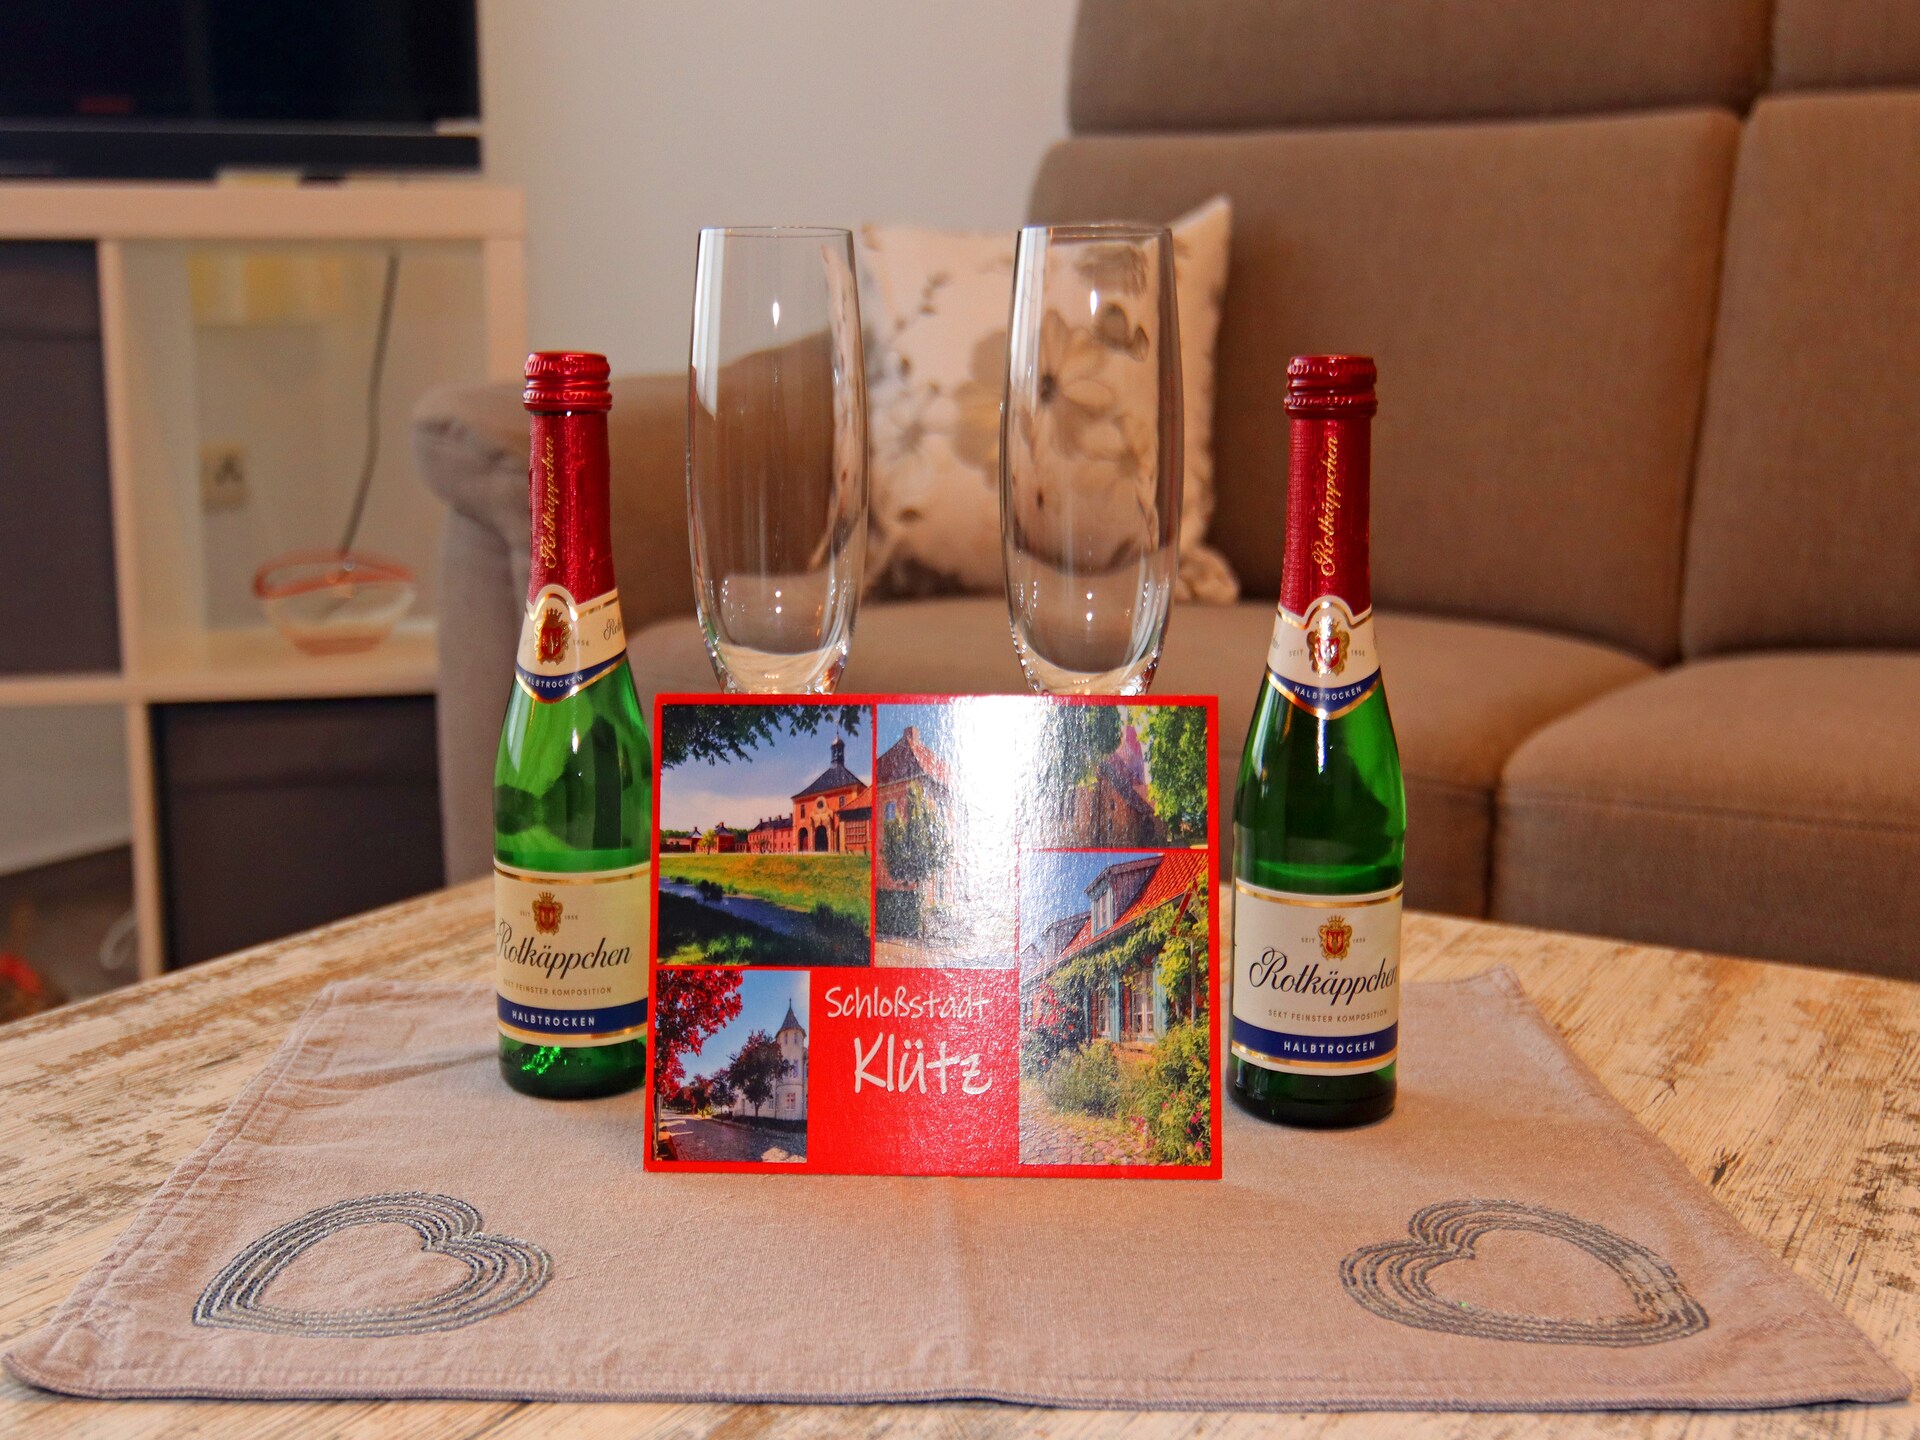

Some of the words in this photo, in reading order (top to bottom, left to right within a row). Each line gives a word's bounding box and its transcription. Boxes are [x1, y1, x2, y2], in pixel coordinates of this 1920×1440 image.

[1312, 436, 1342, 577] Rotkäppchen
[1294, 685, 1362, 701] HALBTROCKEN
[497, 918, 633, 980] Rotkäppchen
[1249, 946, 1398, 1006] Rotkäppchen
[515, 983, 549, 995] FEINSTER
[552, 986, 612, 996] KOMPOSITION
[825, 985, 993, 1019] Schloßstadt
[511, 1010, 595, 1027] HALBTROCKEN
[1268, 1009, 1287, 1019] SEKT
[1291, 1013, 1333, 1023] FEINSTER
[1336, 1009, 1388, 1022] KOMPOSITION
[1283, 1040, 1376, 1054] HALBTROCKEN
[854, 1032, 993, 1095] Klütz
